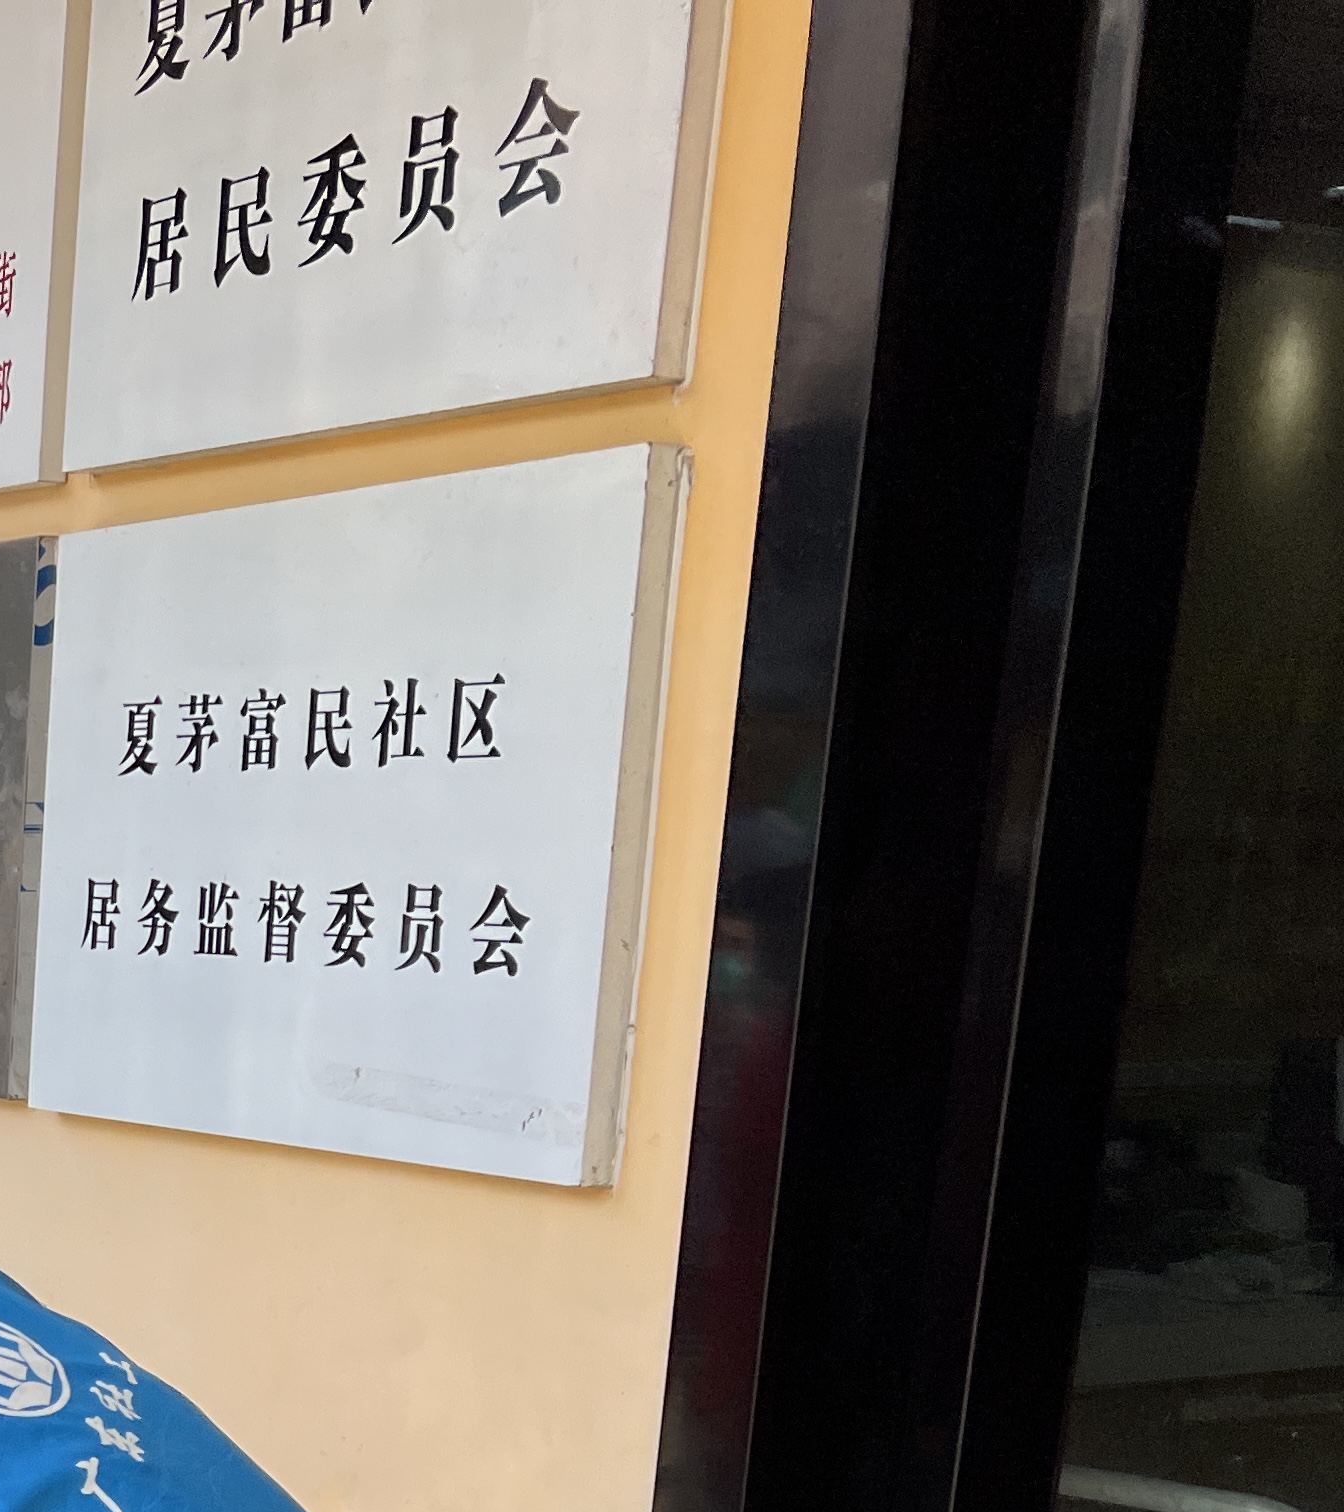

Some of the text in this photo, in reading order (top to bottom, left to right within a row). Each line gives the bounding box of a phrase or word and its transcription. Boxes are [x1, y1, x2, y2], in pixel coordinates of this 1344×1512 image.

[130, 76, 581, 304] 居民委员会
[118, 673, 506, 777] 夏茅富民社区
[81, 876, 531, 979] 居务监督委员会
